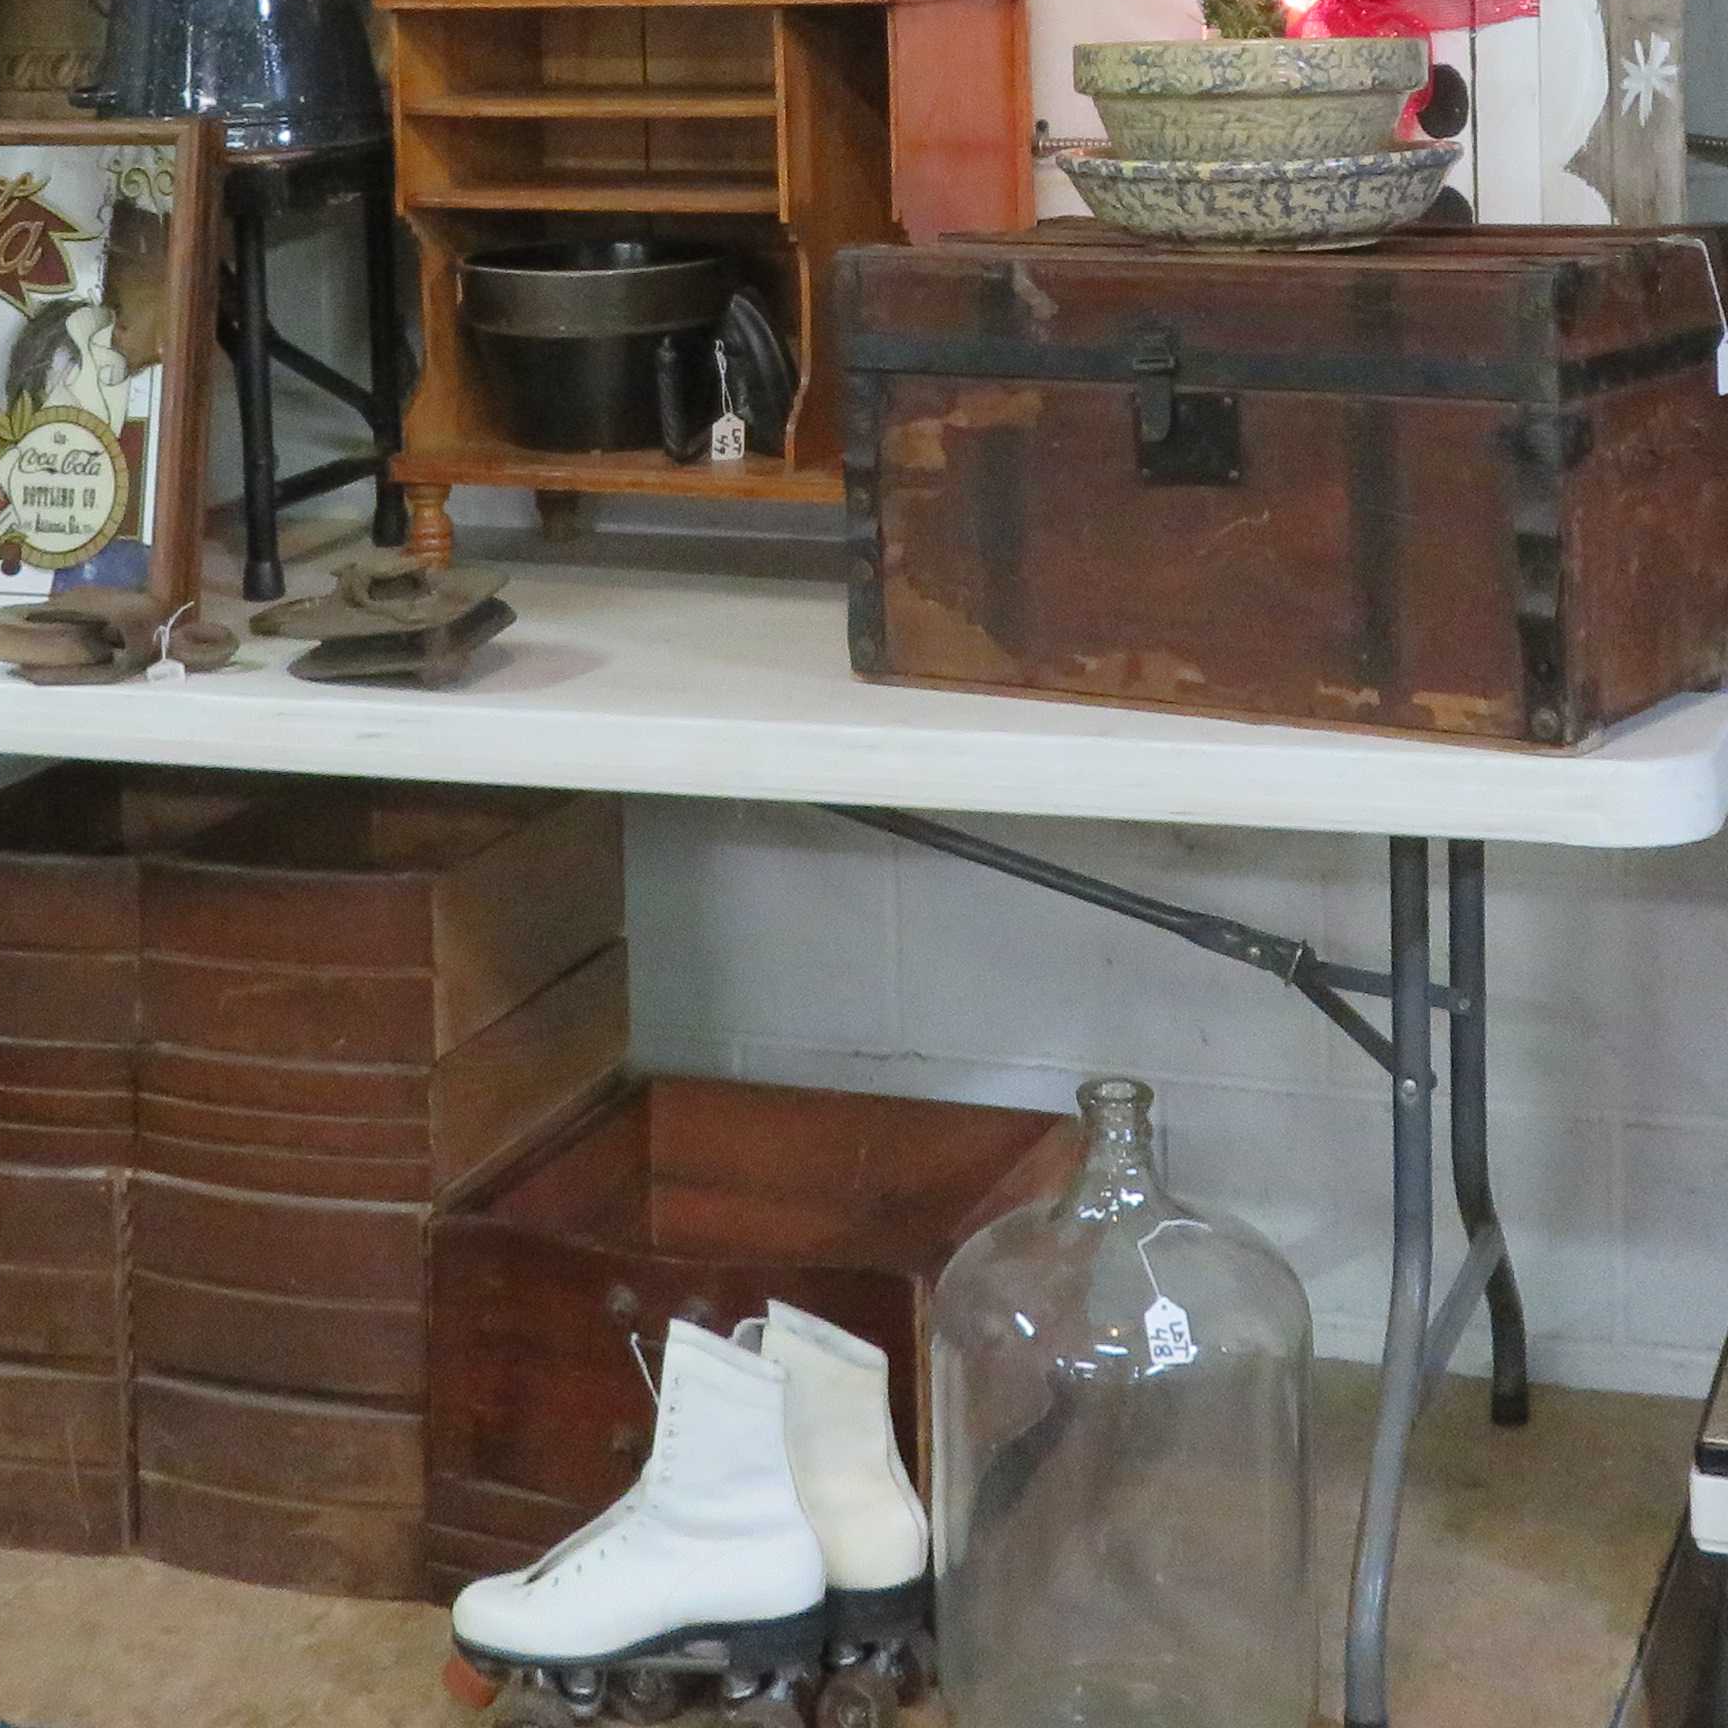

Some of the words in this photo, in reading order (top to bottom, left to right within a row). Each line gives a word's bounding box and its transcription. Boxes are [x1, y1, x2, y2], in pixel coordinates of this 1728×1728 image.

[732, 428, 742, 456] LOT
[22, 485, 75, 508] BOTTLING
[1151, 1327, 1172, 1358] 48
[1169, 1321, 1189, 1359] LOT
